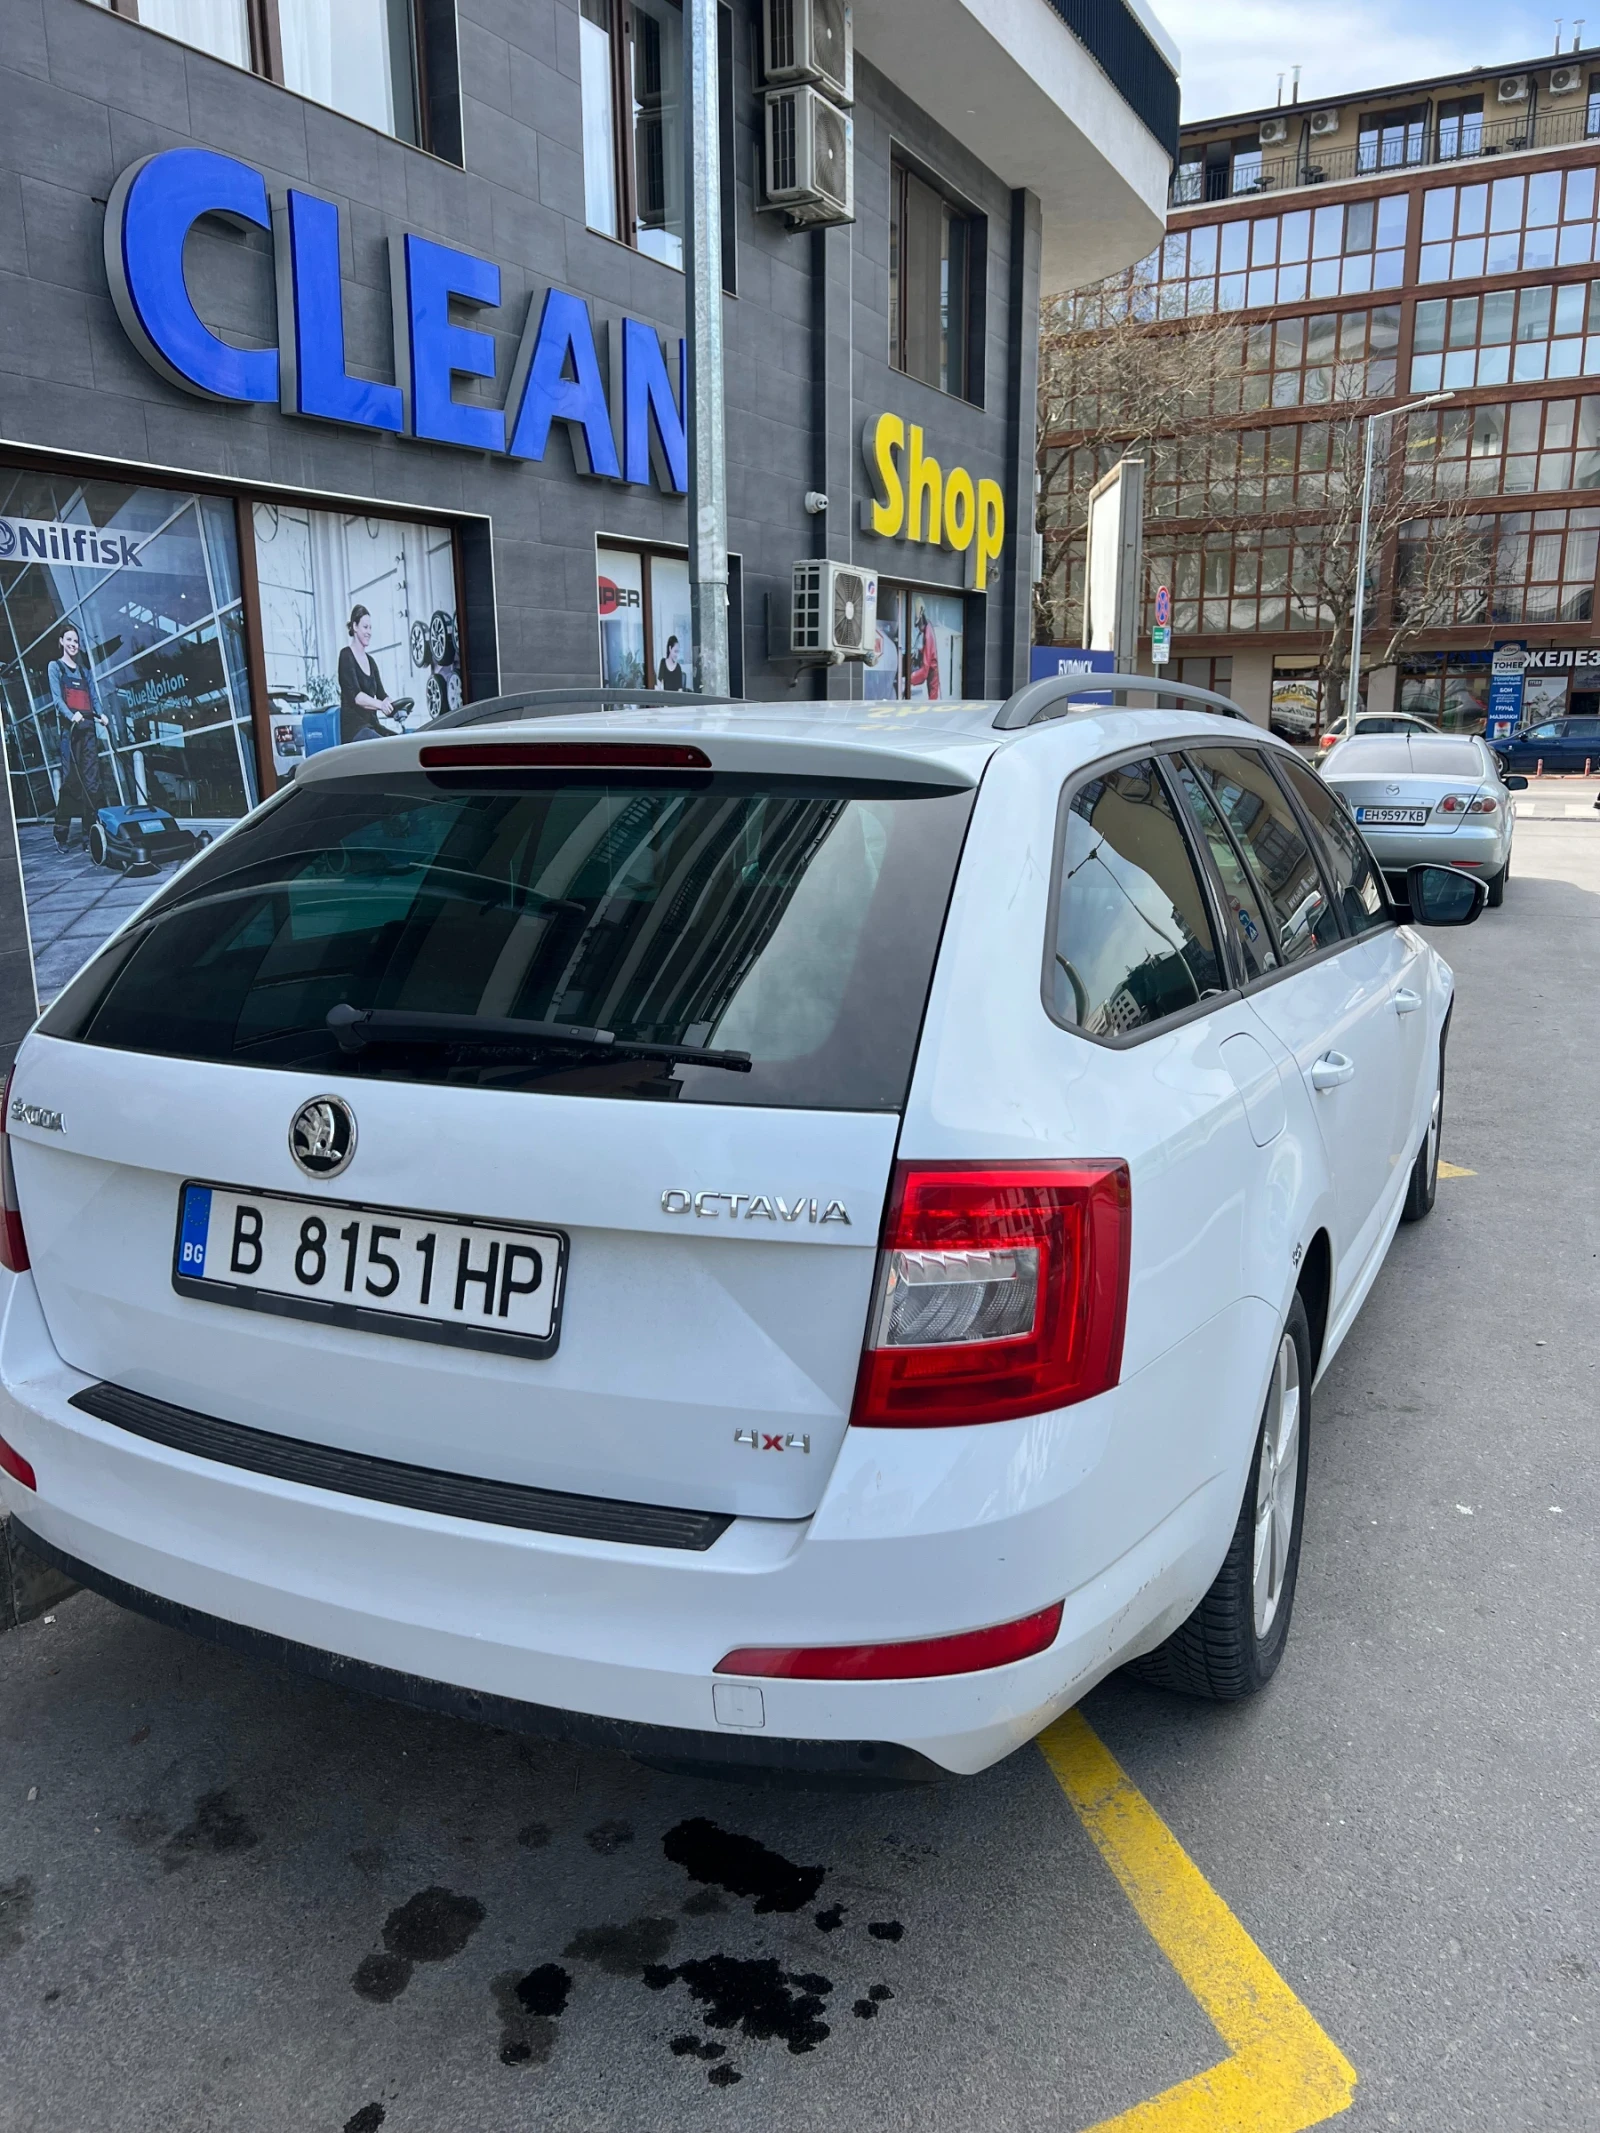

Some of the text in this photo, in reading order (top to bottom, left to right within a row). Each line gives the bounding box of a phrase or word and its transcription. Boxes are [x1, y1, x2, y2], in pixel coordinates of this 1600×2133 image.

[104, 147, 688, 495] CLEAN
[866, 412, 1005, 590] Shop
[18, 525, 143, 567] Nilfisk
[126, 673, 186, 708] BlueMotion
[1365, 810, 1424, 821] EH 9597 KB
[661, 1189, 852, 1225] OCTAVIA
[183, 1242, 203, 1264] BG
[230, 1205, 543, 1317] B 8151 HP
